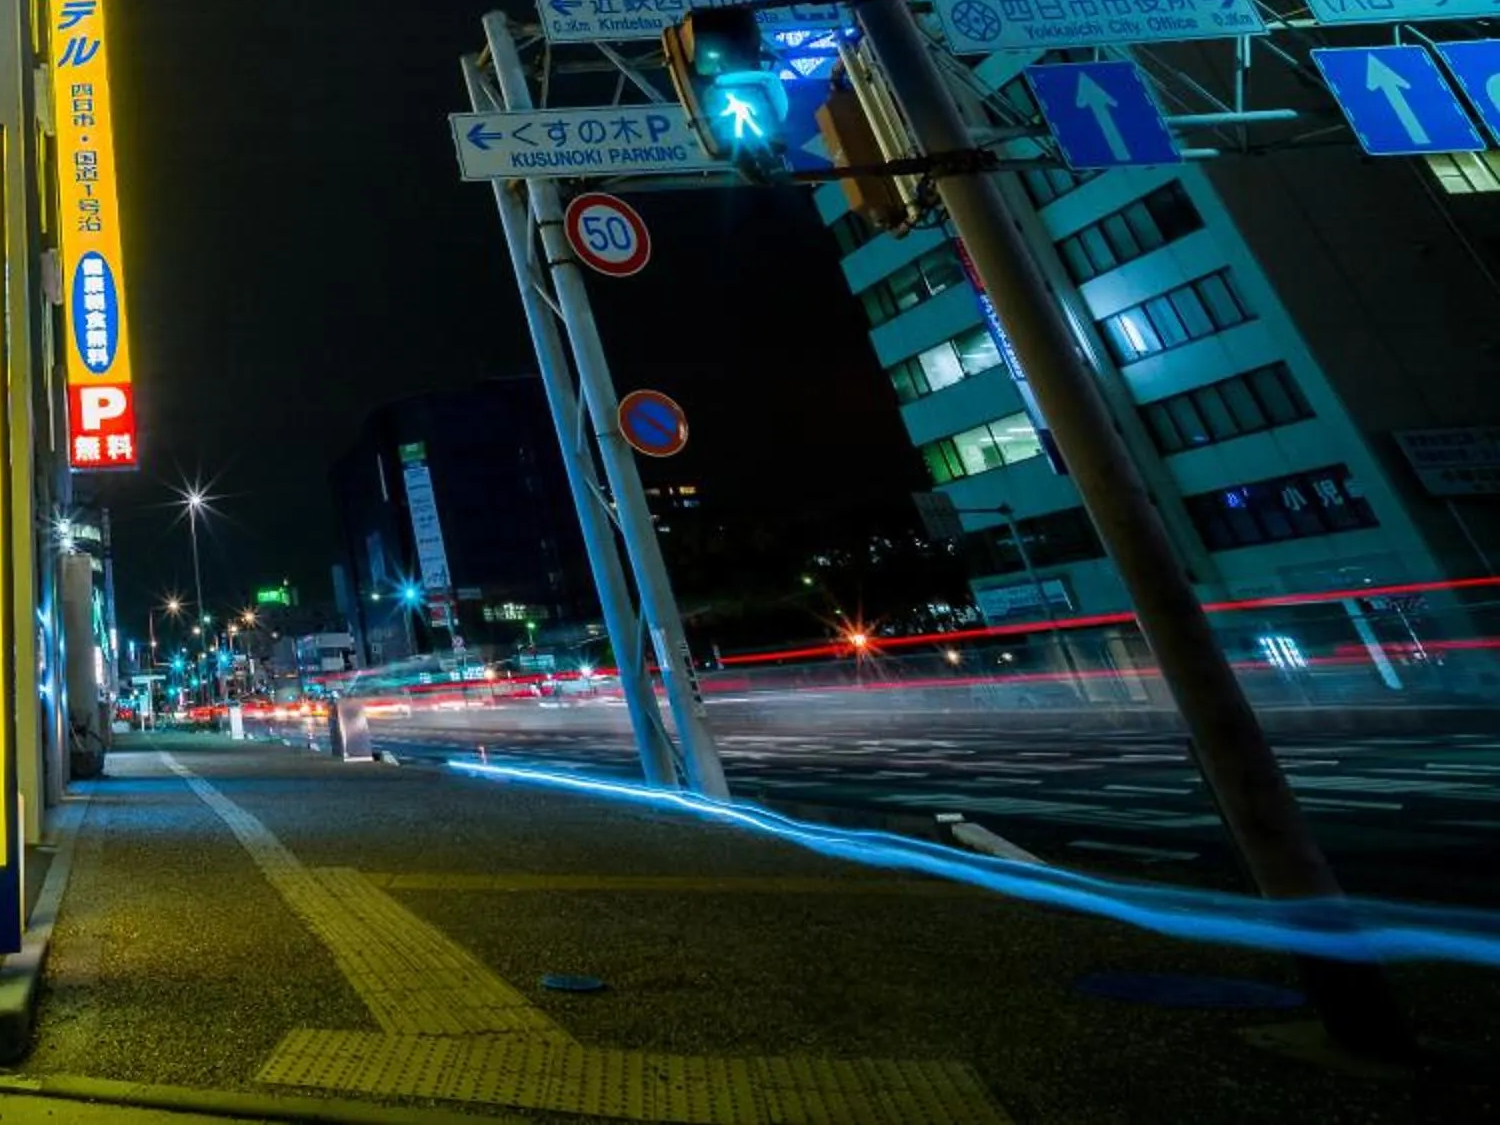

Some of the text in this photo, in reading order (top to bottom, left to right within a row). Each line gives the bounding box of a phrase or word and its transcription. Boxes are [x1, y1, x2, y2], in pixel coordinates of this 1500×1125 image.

[598, 16, 663, 31] Kintetsu
[1023, 21, 1105, 41] Yokkaichi
[1109, 18, 1141, 35] City
[1148, 15, 1199, 32] Office
[510, 142, 687, 168] KUSUNOKI PARKING
[581, 215, 632, 251] 50
[80, 386, 127, 431] P
[74, 434, 133, 461] 無料
